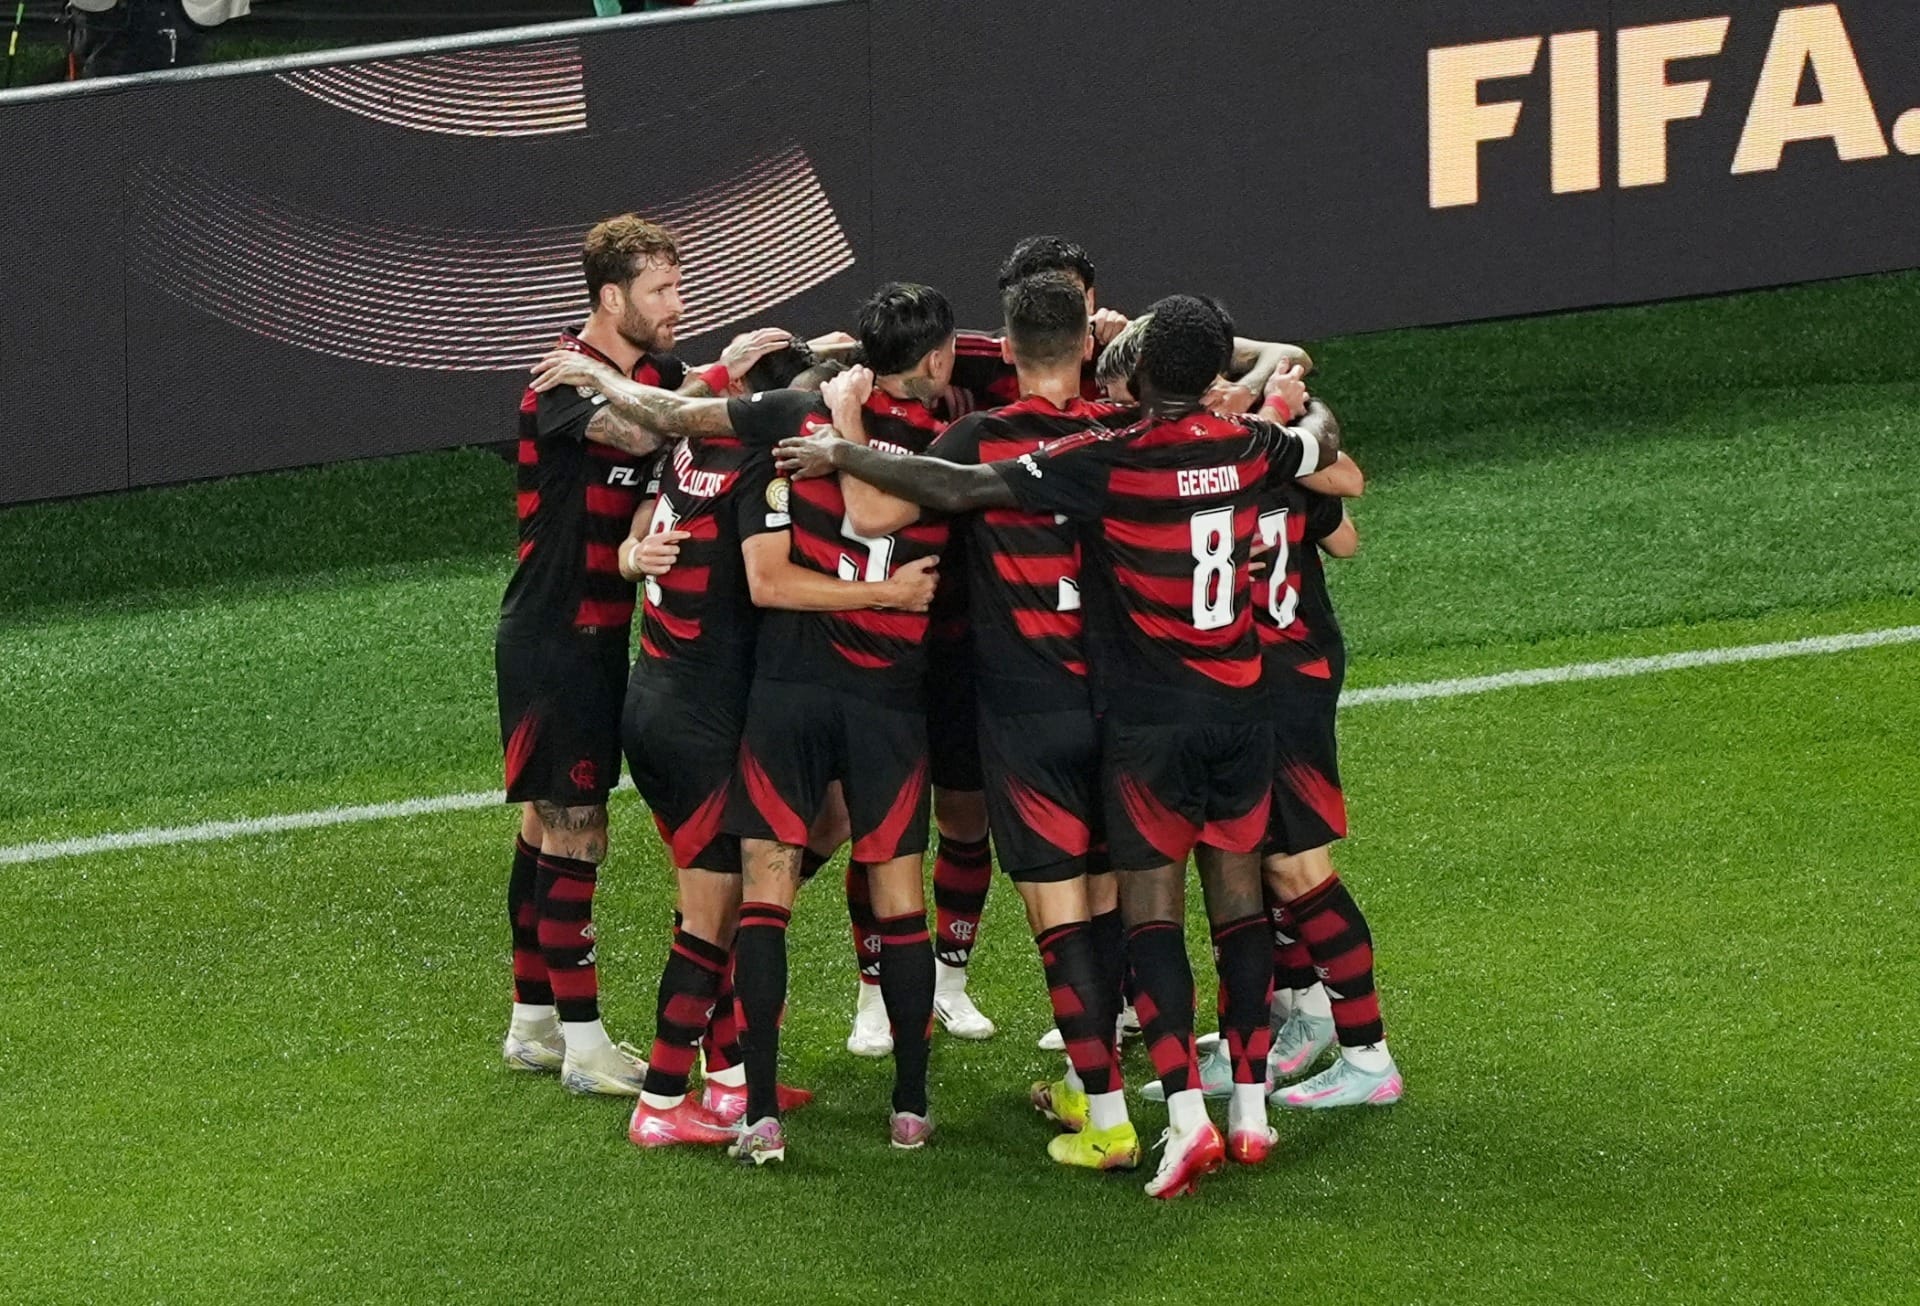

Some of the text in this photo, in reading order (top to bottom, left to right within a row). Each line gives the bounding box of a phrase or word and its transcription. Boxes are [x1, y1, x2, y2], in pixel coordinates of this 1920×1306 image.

[607, 466, 640, 486] FL
[1177, 465, 1240, 497] GERSON
[1190, 505, 1235, 630] 8
[1258, 508, 1299, 629] 2
